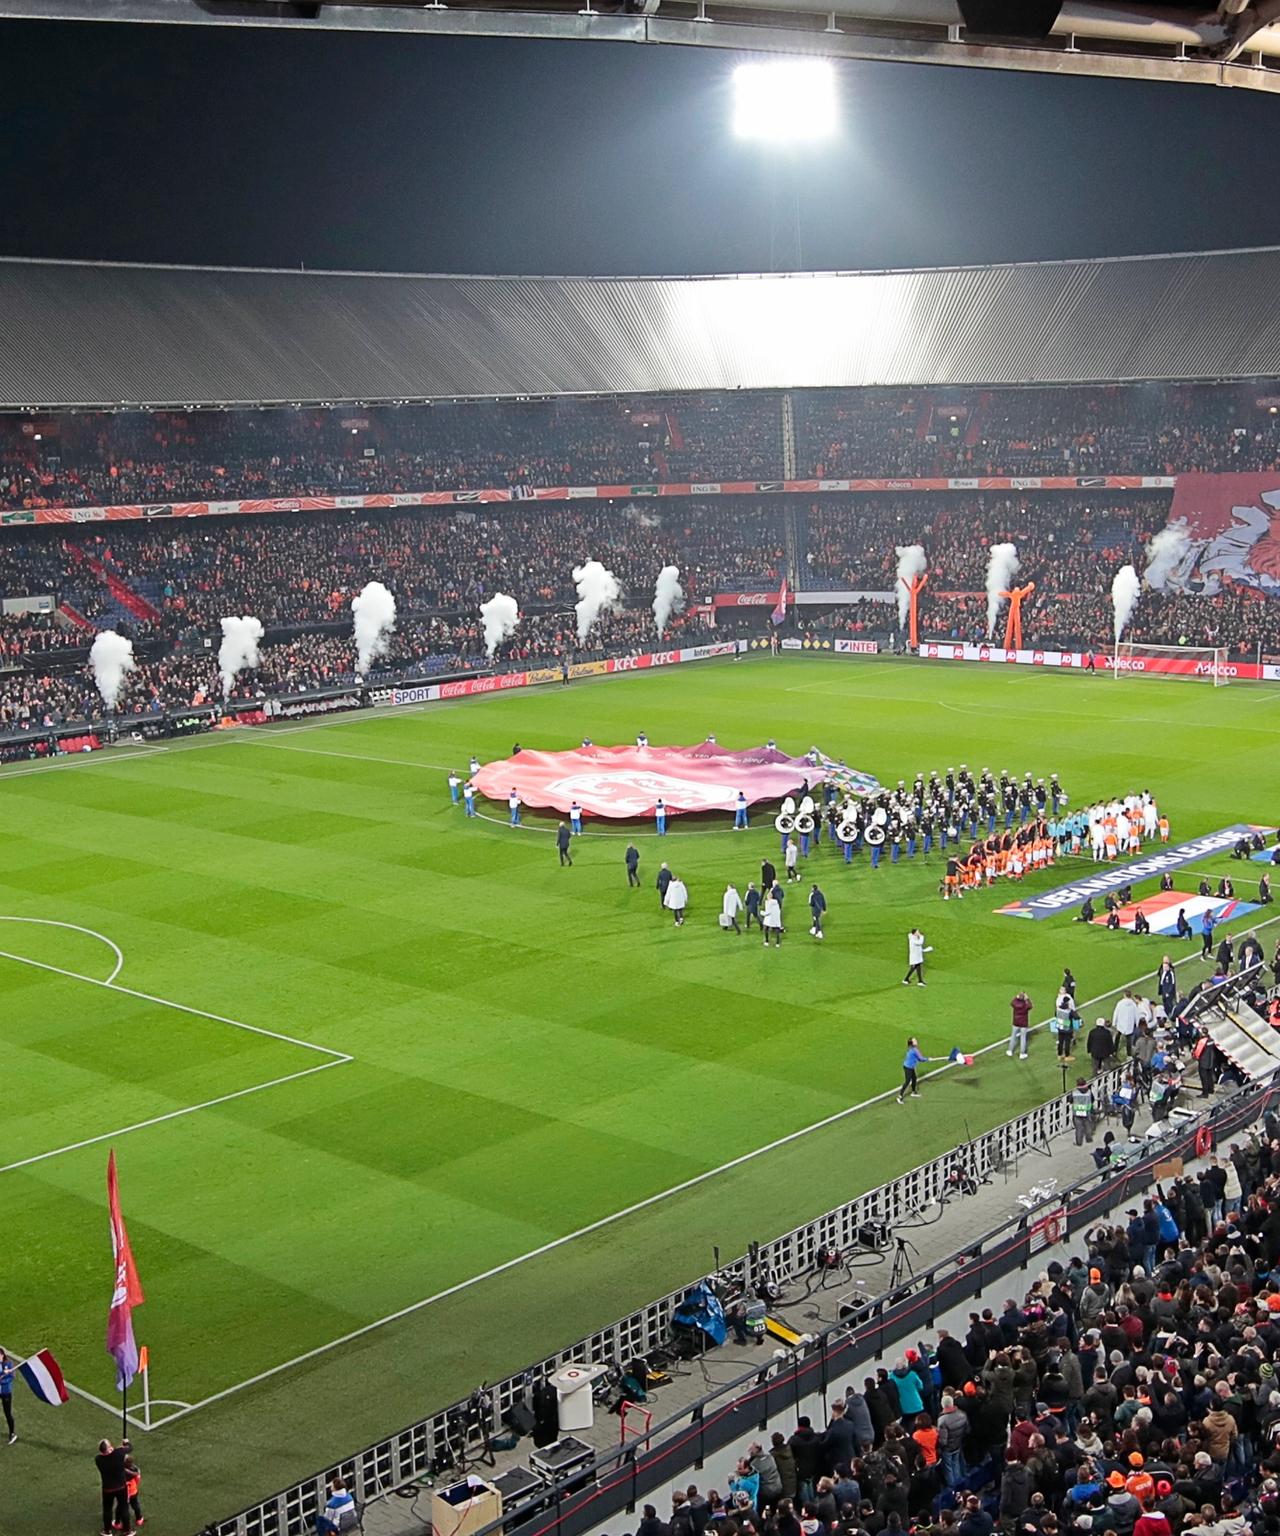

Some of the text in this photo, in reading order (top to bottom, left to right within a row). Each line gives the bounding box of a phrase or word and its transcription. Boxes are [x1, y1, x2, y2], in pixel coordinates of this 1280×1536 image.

[692, 485, 707, 494] ING
[1012, 480, 1028, 488] ING
[73, 510, 92, 520] ING
[613, 657, 639, 671] KFC
[650, 653, 675, 666] KFC
[1027, 830, 1253, 909] UEFA NATIONS LEAGUE
